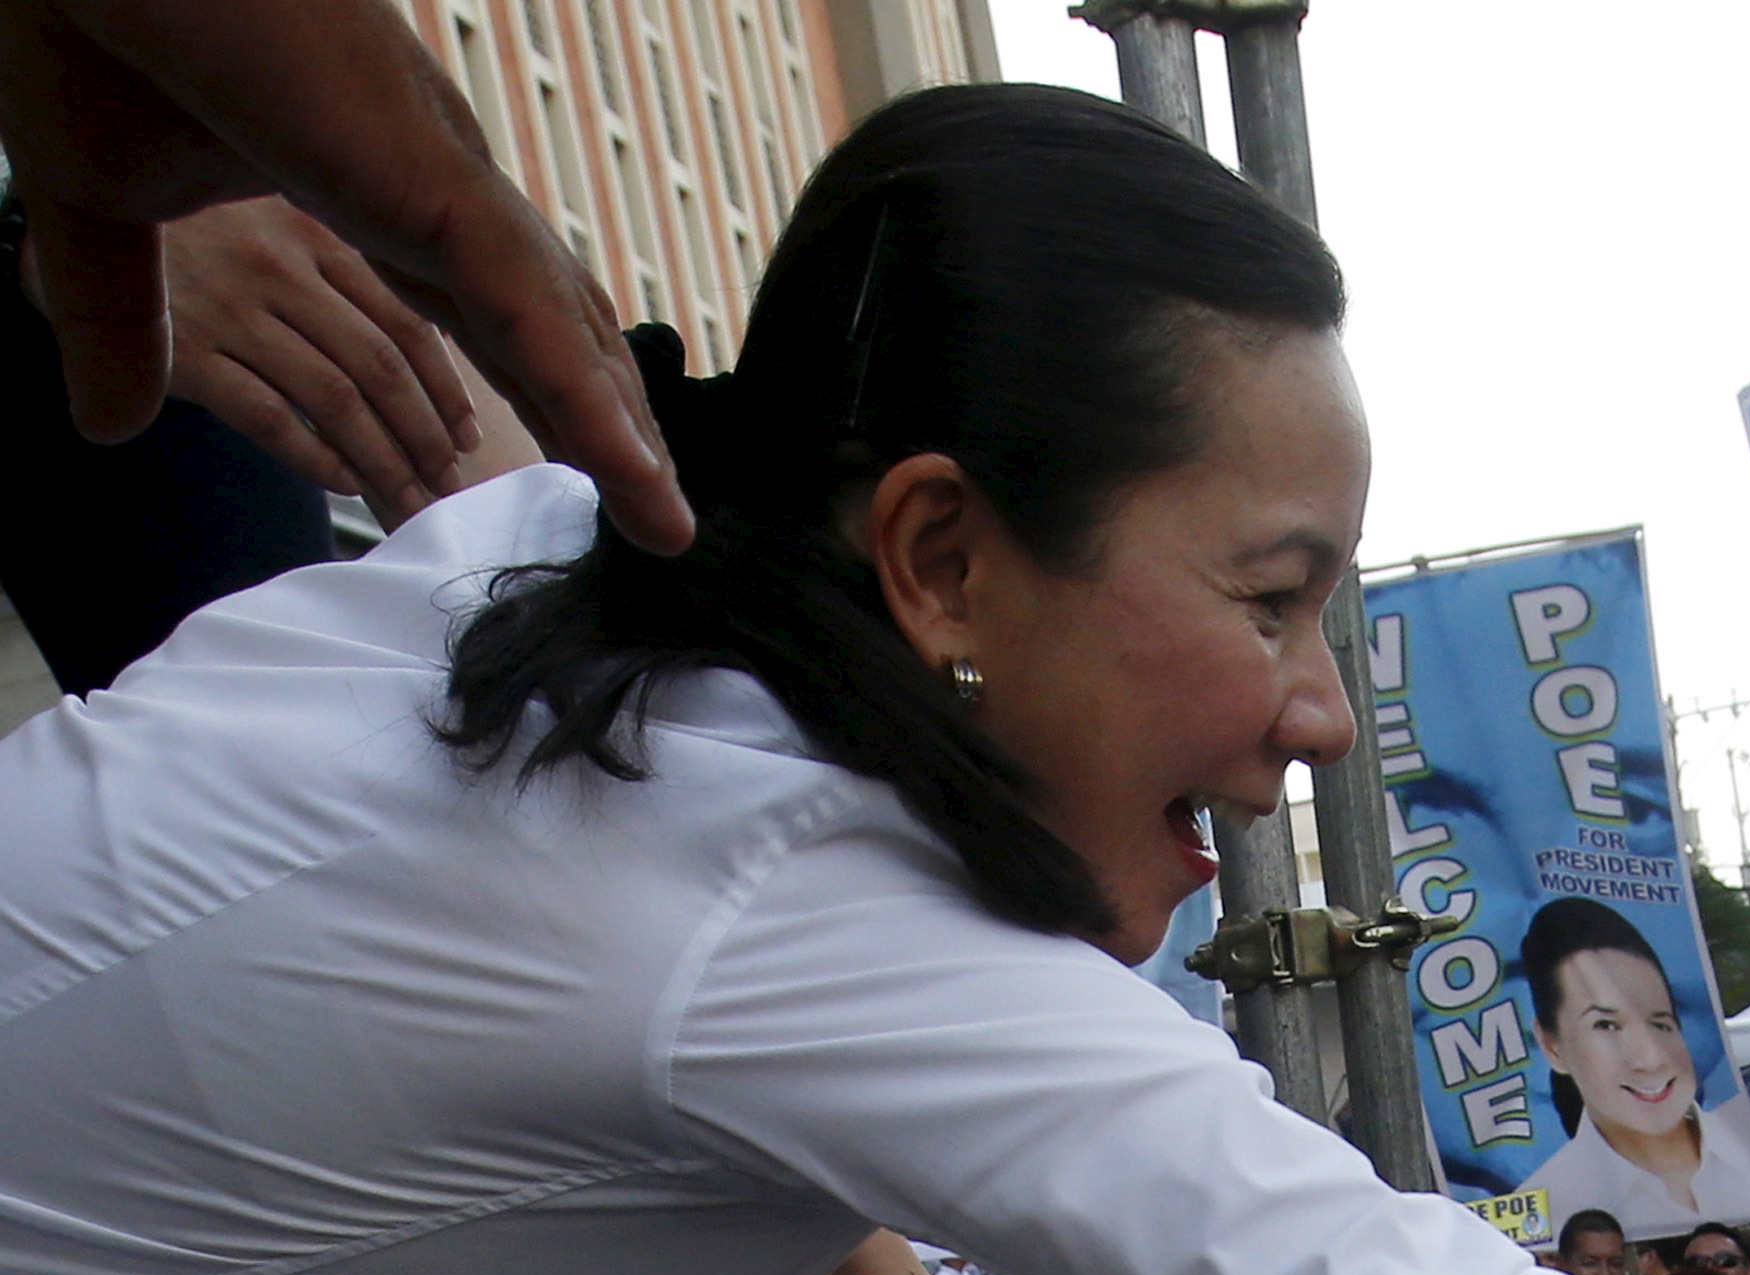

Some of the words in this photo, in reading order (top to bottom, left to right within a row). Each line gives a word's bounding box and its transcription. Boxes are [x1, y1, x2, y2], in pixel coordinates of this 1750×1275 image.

[1508, 582, 1628, 822] POE
[1577, 826, 1626, 850] FOR
[1534, 848, 1675, 879] PRESIDENT
[1539, 872, 1681, 903] MOVEMENT
[1494, 1194, 1537, 1219] POE
